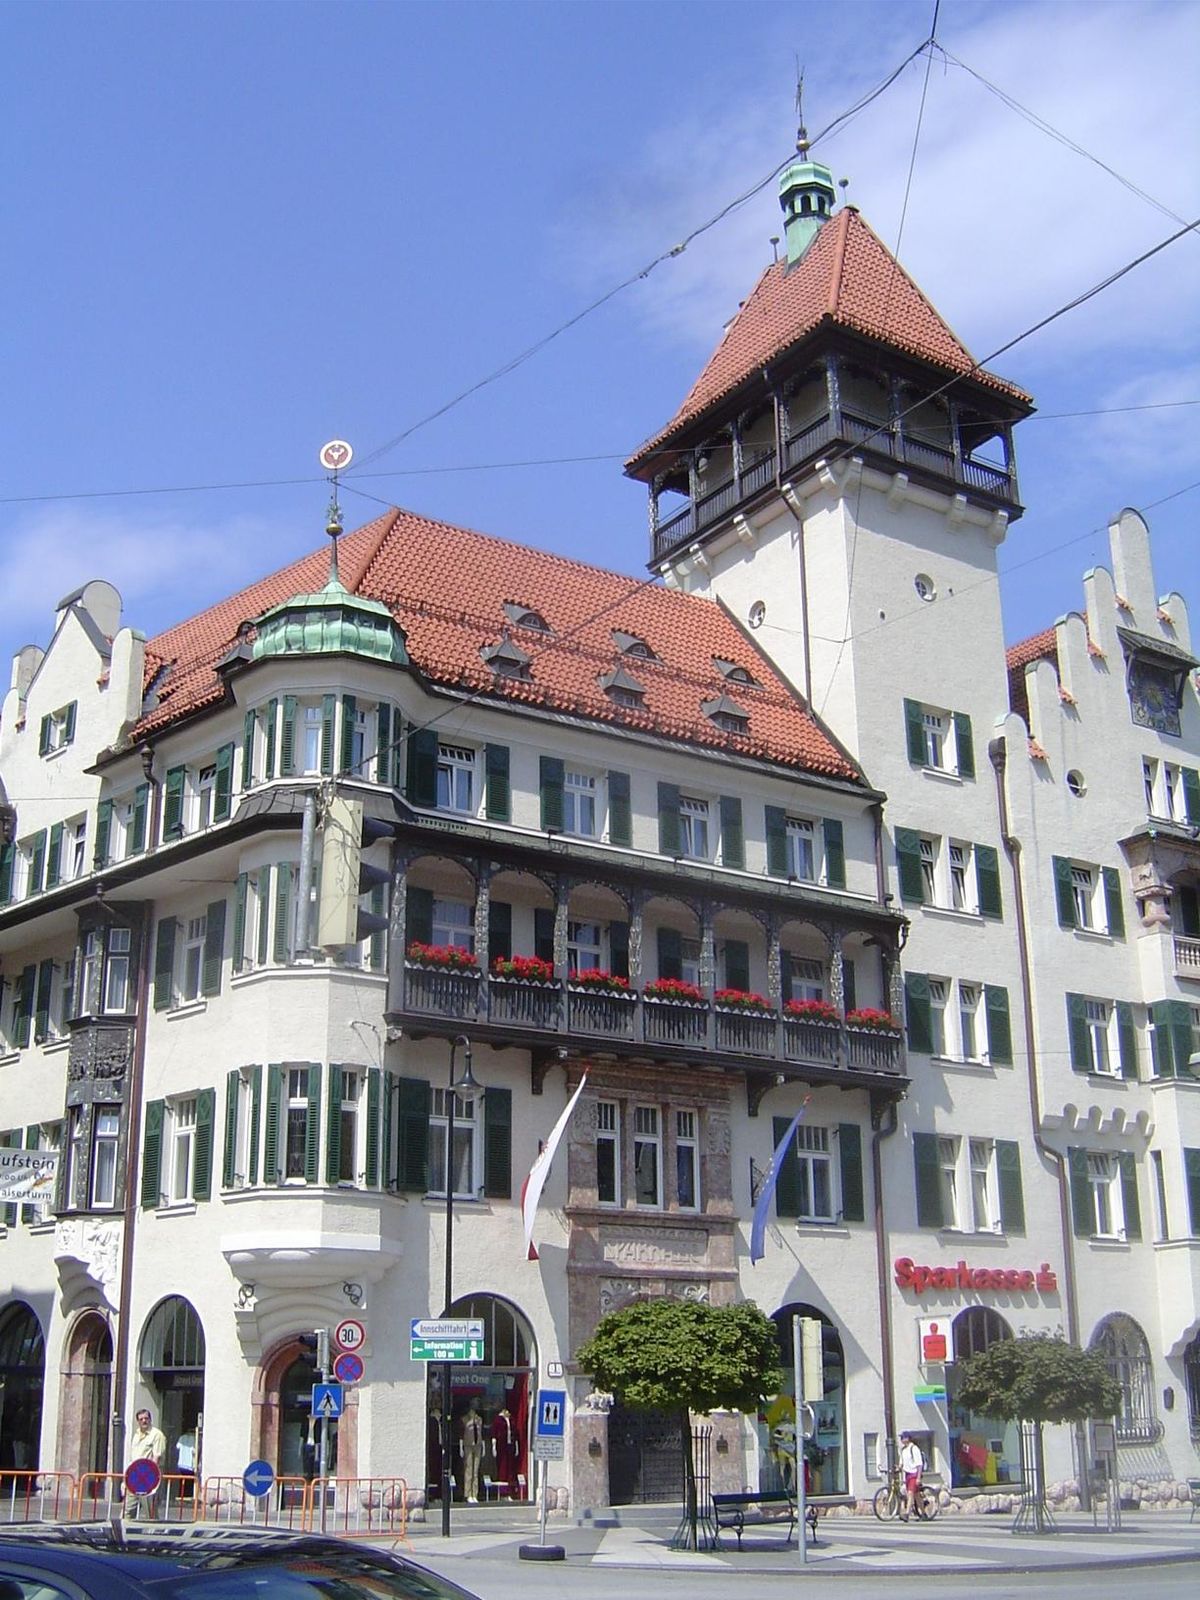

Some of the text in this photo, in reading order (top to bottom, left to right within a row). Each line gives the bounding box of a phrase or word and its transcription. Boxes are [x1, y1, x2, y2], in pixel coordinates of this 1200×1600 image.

[0, 1154, 54, 1170] ufstein
[0, 1188, 52, 1200] aiserturm
[894, 1257, 1035, 1295] Sparkasse
[341, 1328, 354, 1343] 30
[424, 1341, 464, 1350] Information
[433, 1350, 447, 1358] 100
[446, 1374, 490, 1385] reet One
